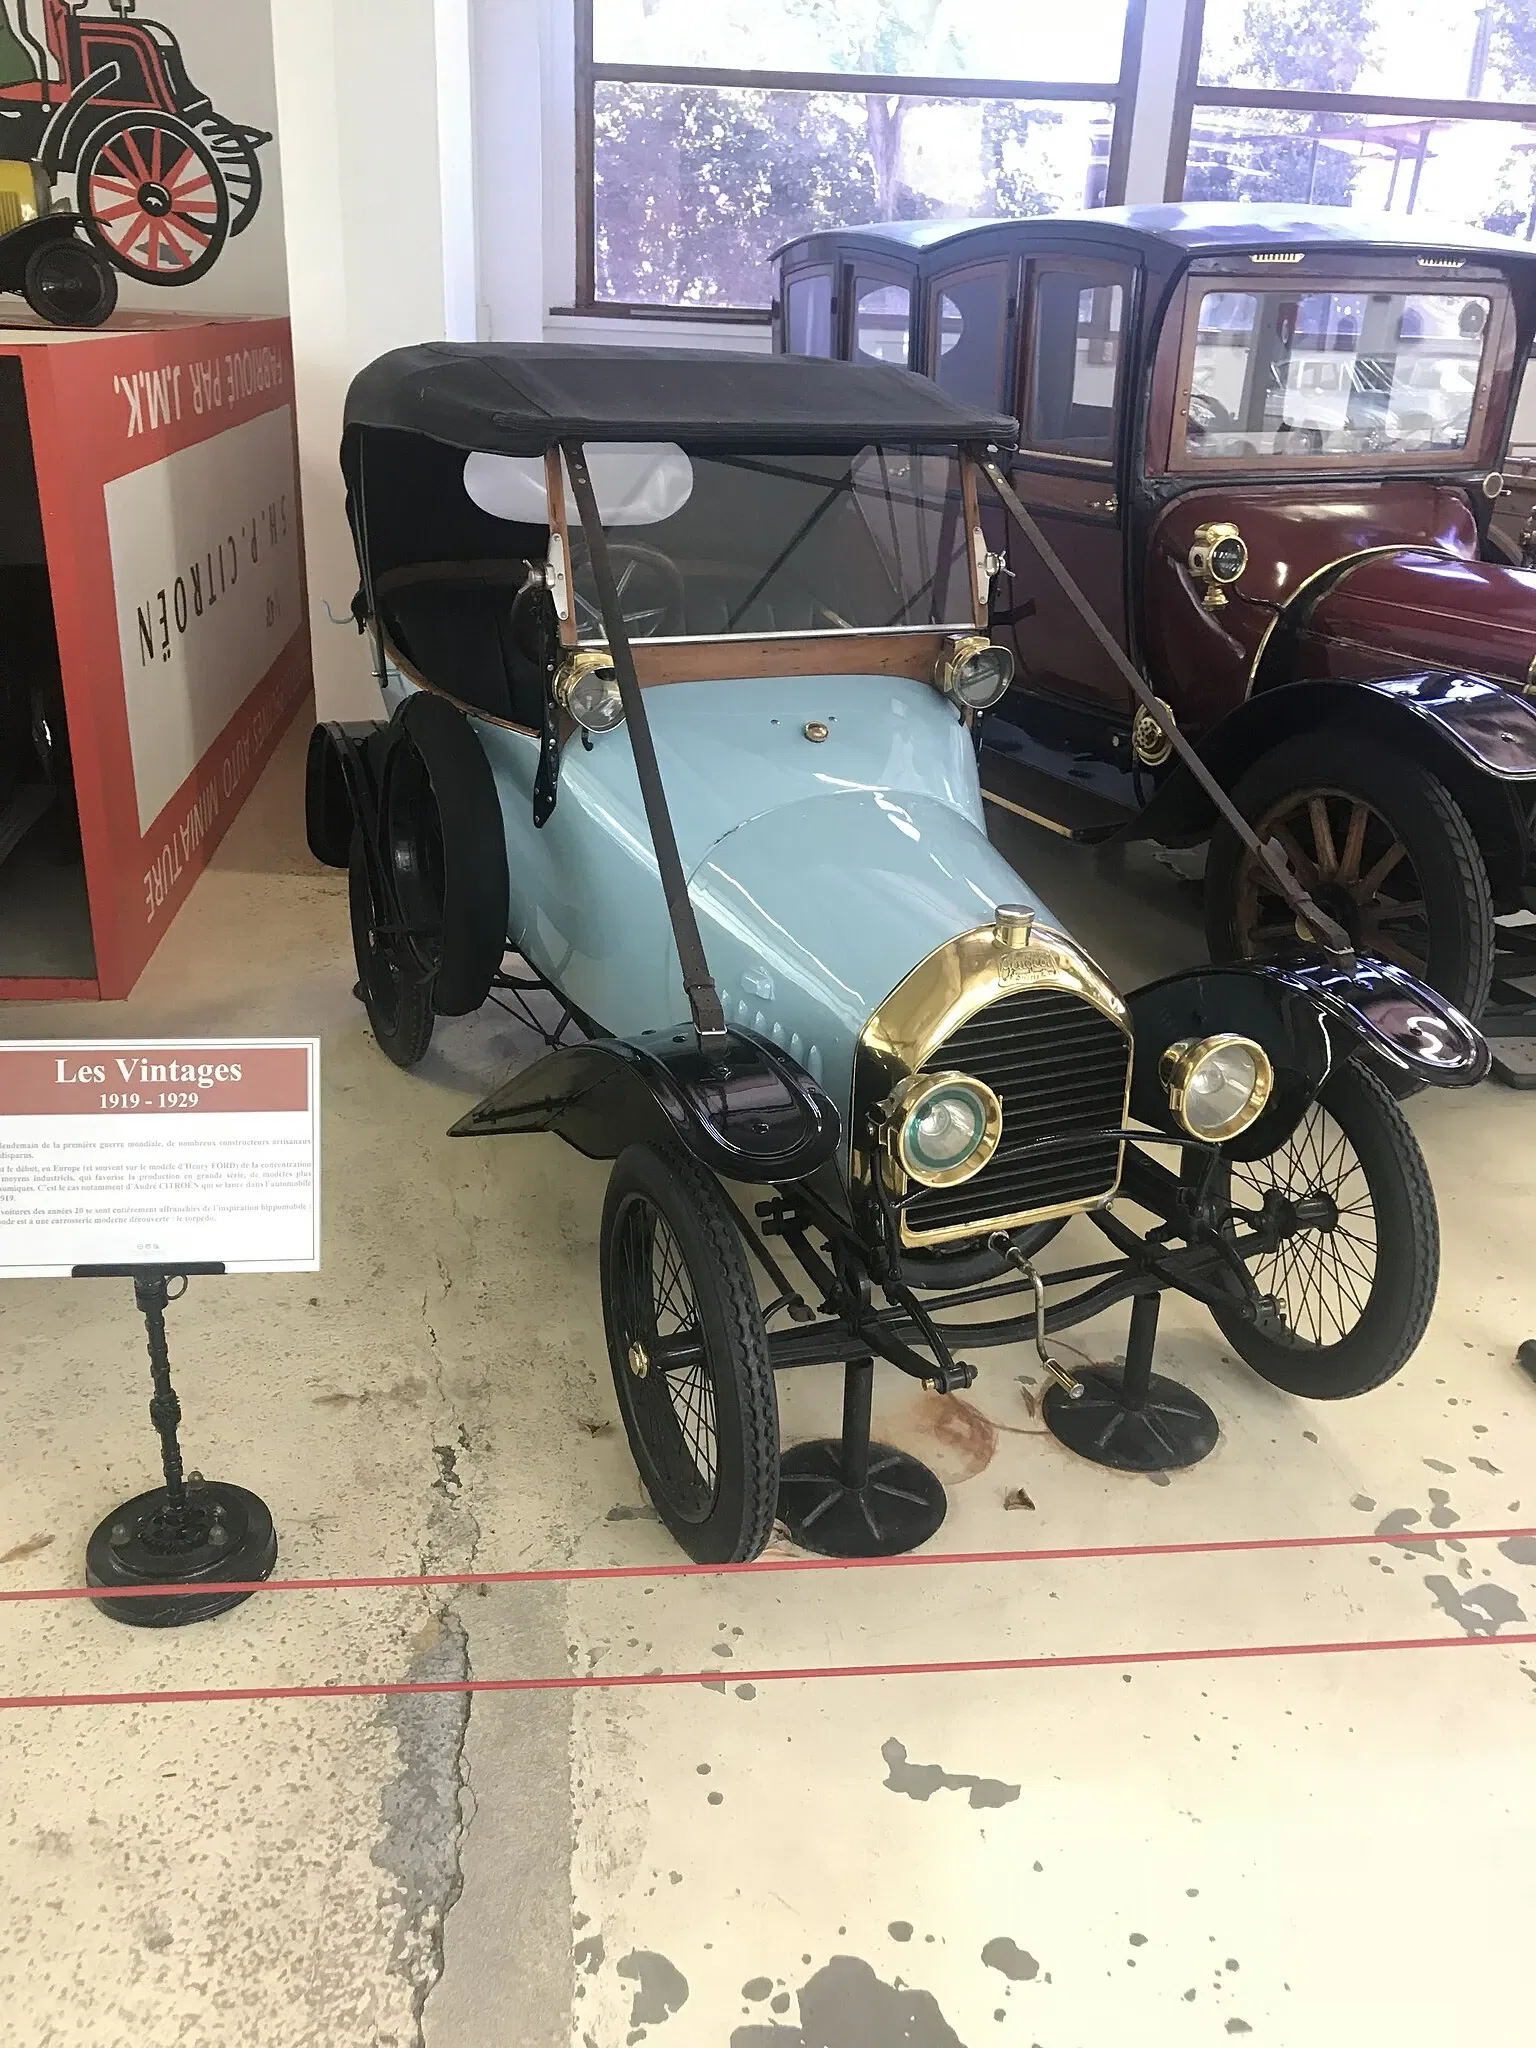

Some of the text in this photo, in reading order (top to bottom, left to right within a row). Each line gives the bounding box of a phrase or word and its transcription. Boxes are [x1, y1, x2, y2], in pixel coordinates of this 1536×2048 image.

[113, 345, 284, 439] FABRIQUÉ PAR J.M.K.
[137, 535, 238, 667] CITROËN
[143, 734, 250, 924] AUTO MINIATURE
[55, 1057, 242, 1089] Les Vintages
[100, 1093, 141, 1109] 1919
[158, 1092, 199, 1108] 1929
[41, 1141, 50, 1149] de
[53, 1141, 60, 1149] la
[63, 1141, 96, 1150] première
[219, 1138, 269, 1146] constructeurs
[7, 1165, 13, 1173] le
[53, 1165, 80, 1173] Europe
[241, 1161, 249, 1169] de
[252, 1161, 259, 1169] la
[79, 1174, 92, 1182] qui
[139, 1173, 180, 1181] production
[296, 1170, 312, 1178] plus
[201, 1182, 214, 1190] qui
[1, 1208, 31, 1216] voitures
[47, 1207, 72, 1215] années
